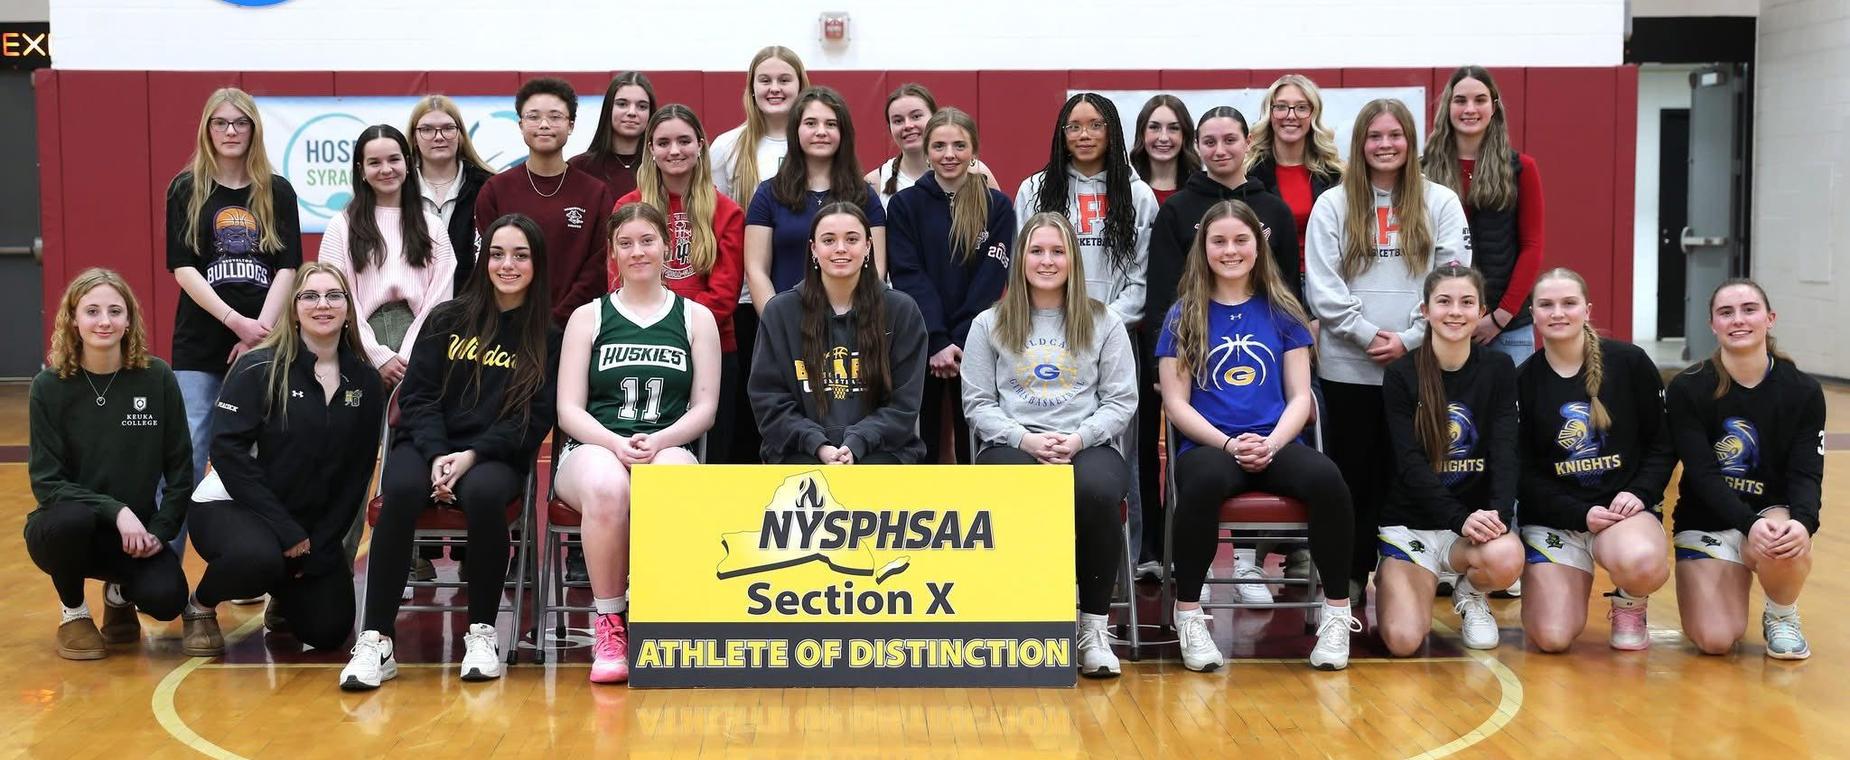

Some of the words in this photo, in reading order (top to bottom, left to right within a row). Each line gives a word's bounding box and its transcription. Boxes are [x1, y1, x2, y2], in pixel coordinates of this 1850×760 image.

[306, 169, 354, 186] SYRA
[207, 263, 268, 284] BULLDOGS
[602, 347, 684, 366] HUSKIES
[1034, 364, 1060, 380] G
[1224, 366, 1256, 386] G
[618, 377, 664, 424] 11
[1440, 459, 1485, 472] IGHTS
[1555, 455, 1622, 475] KNIGHTS
[758, 509, 995, 550] NYSPHSAA
[747, 581, 913, 615] Section
[925, 582, 956, 615] X
[636, 638, 789, 668] ATHLETE
[795, 638, 843, 668] OF
[849, 638, 1070, 668] DISTINCTION
